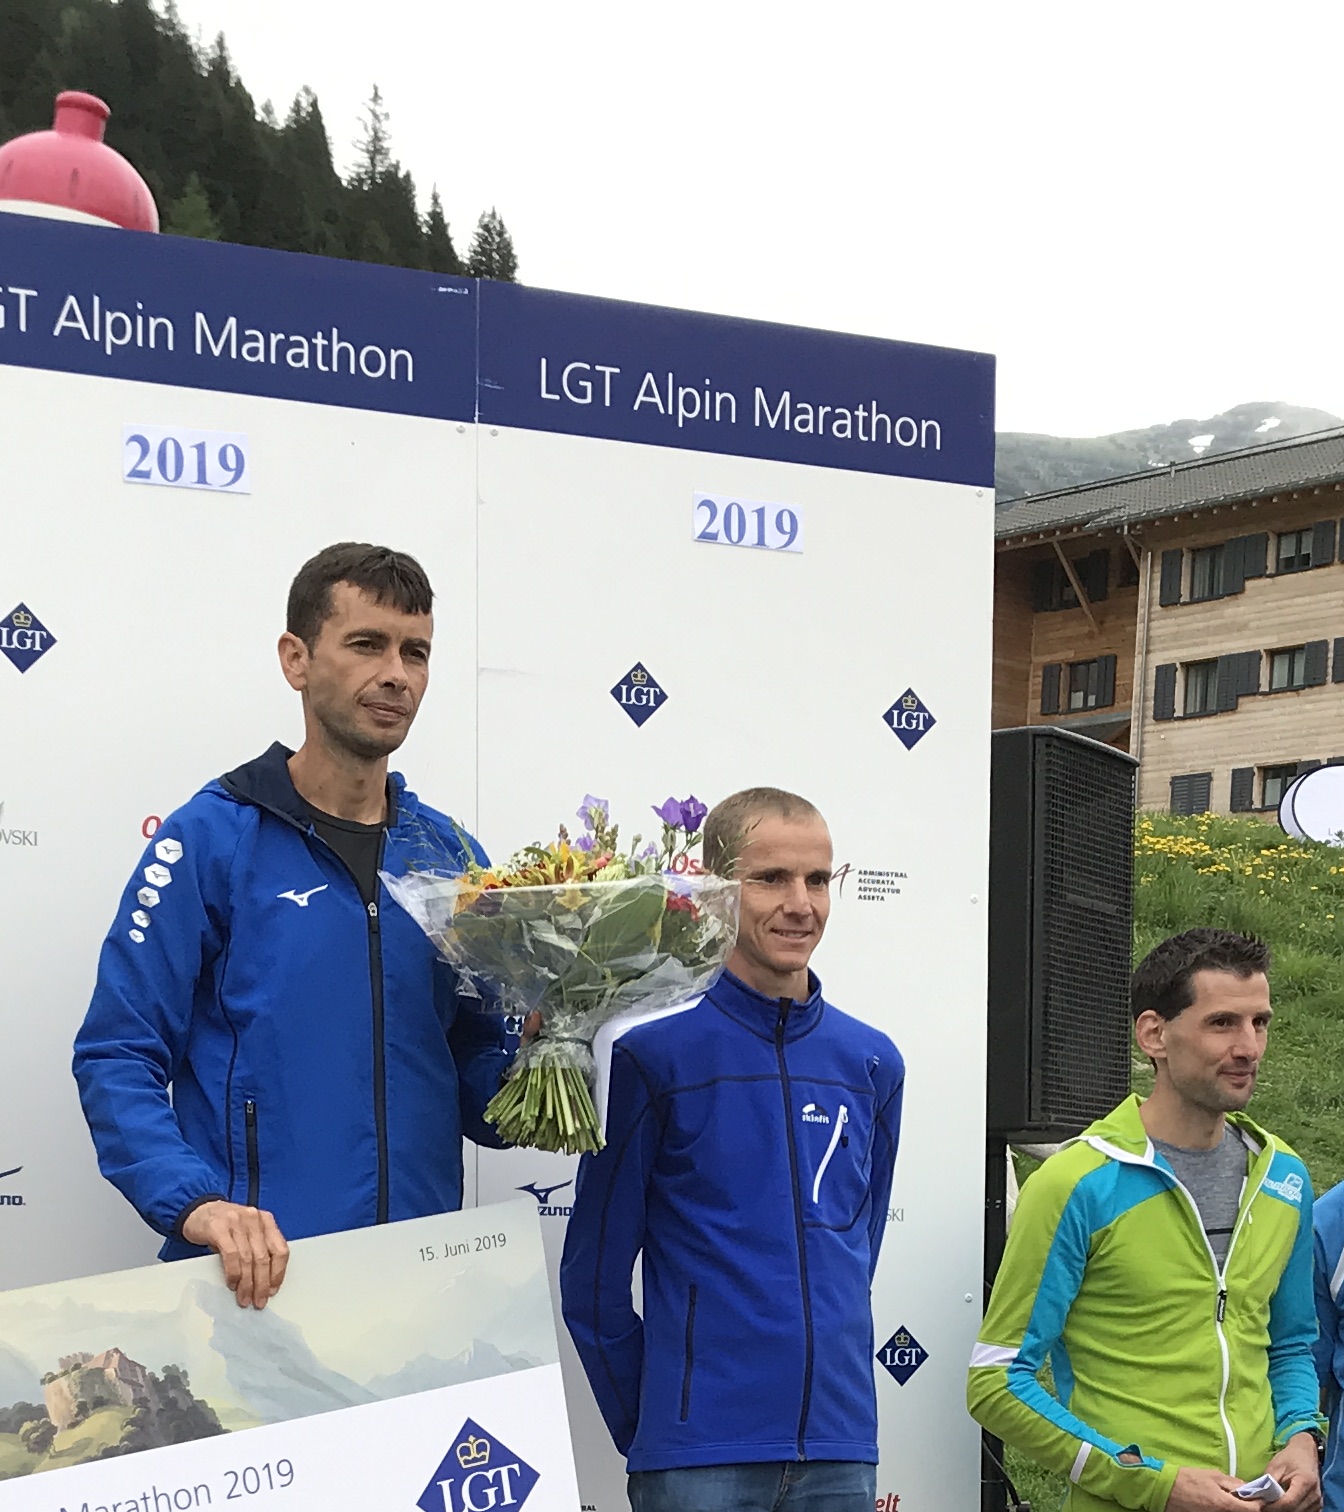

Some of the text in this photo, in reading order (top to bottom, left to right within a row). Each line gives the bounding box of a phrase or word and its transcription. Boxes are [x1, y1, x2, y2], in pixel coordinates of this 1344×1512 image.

[53, 295, 175, 356] Alpin
[194, 311, 415, 383] Marathon
[540, 357, 942, 450] LGT Alpin Marathon
[124, 434, 246, 488] 2019
[696, 499, 799, 550] 2019
[0, 626, 47, 652] LGT
[620, 684, 661, 707] LGT
[891, 710, 929, 732] LGT
[858, 870, 908, 878] ADMINISTRAL
[858, 878, 895, 886] ACCURATA
[858, 886, 901, 894] ADVOCATUR
[858, 894, 885, 902] ASSETA
[539, 1205, 573, 1217] ZUNO
[419, 1233, 507, 1262] 15. Juni 2019
[885, 1346, 921, 1367] LGT
[224, 1458, 296, 1503] 2019
